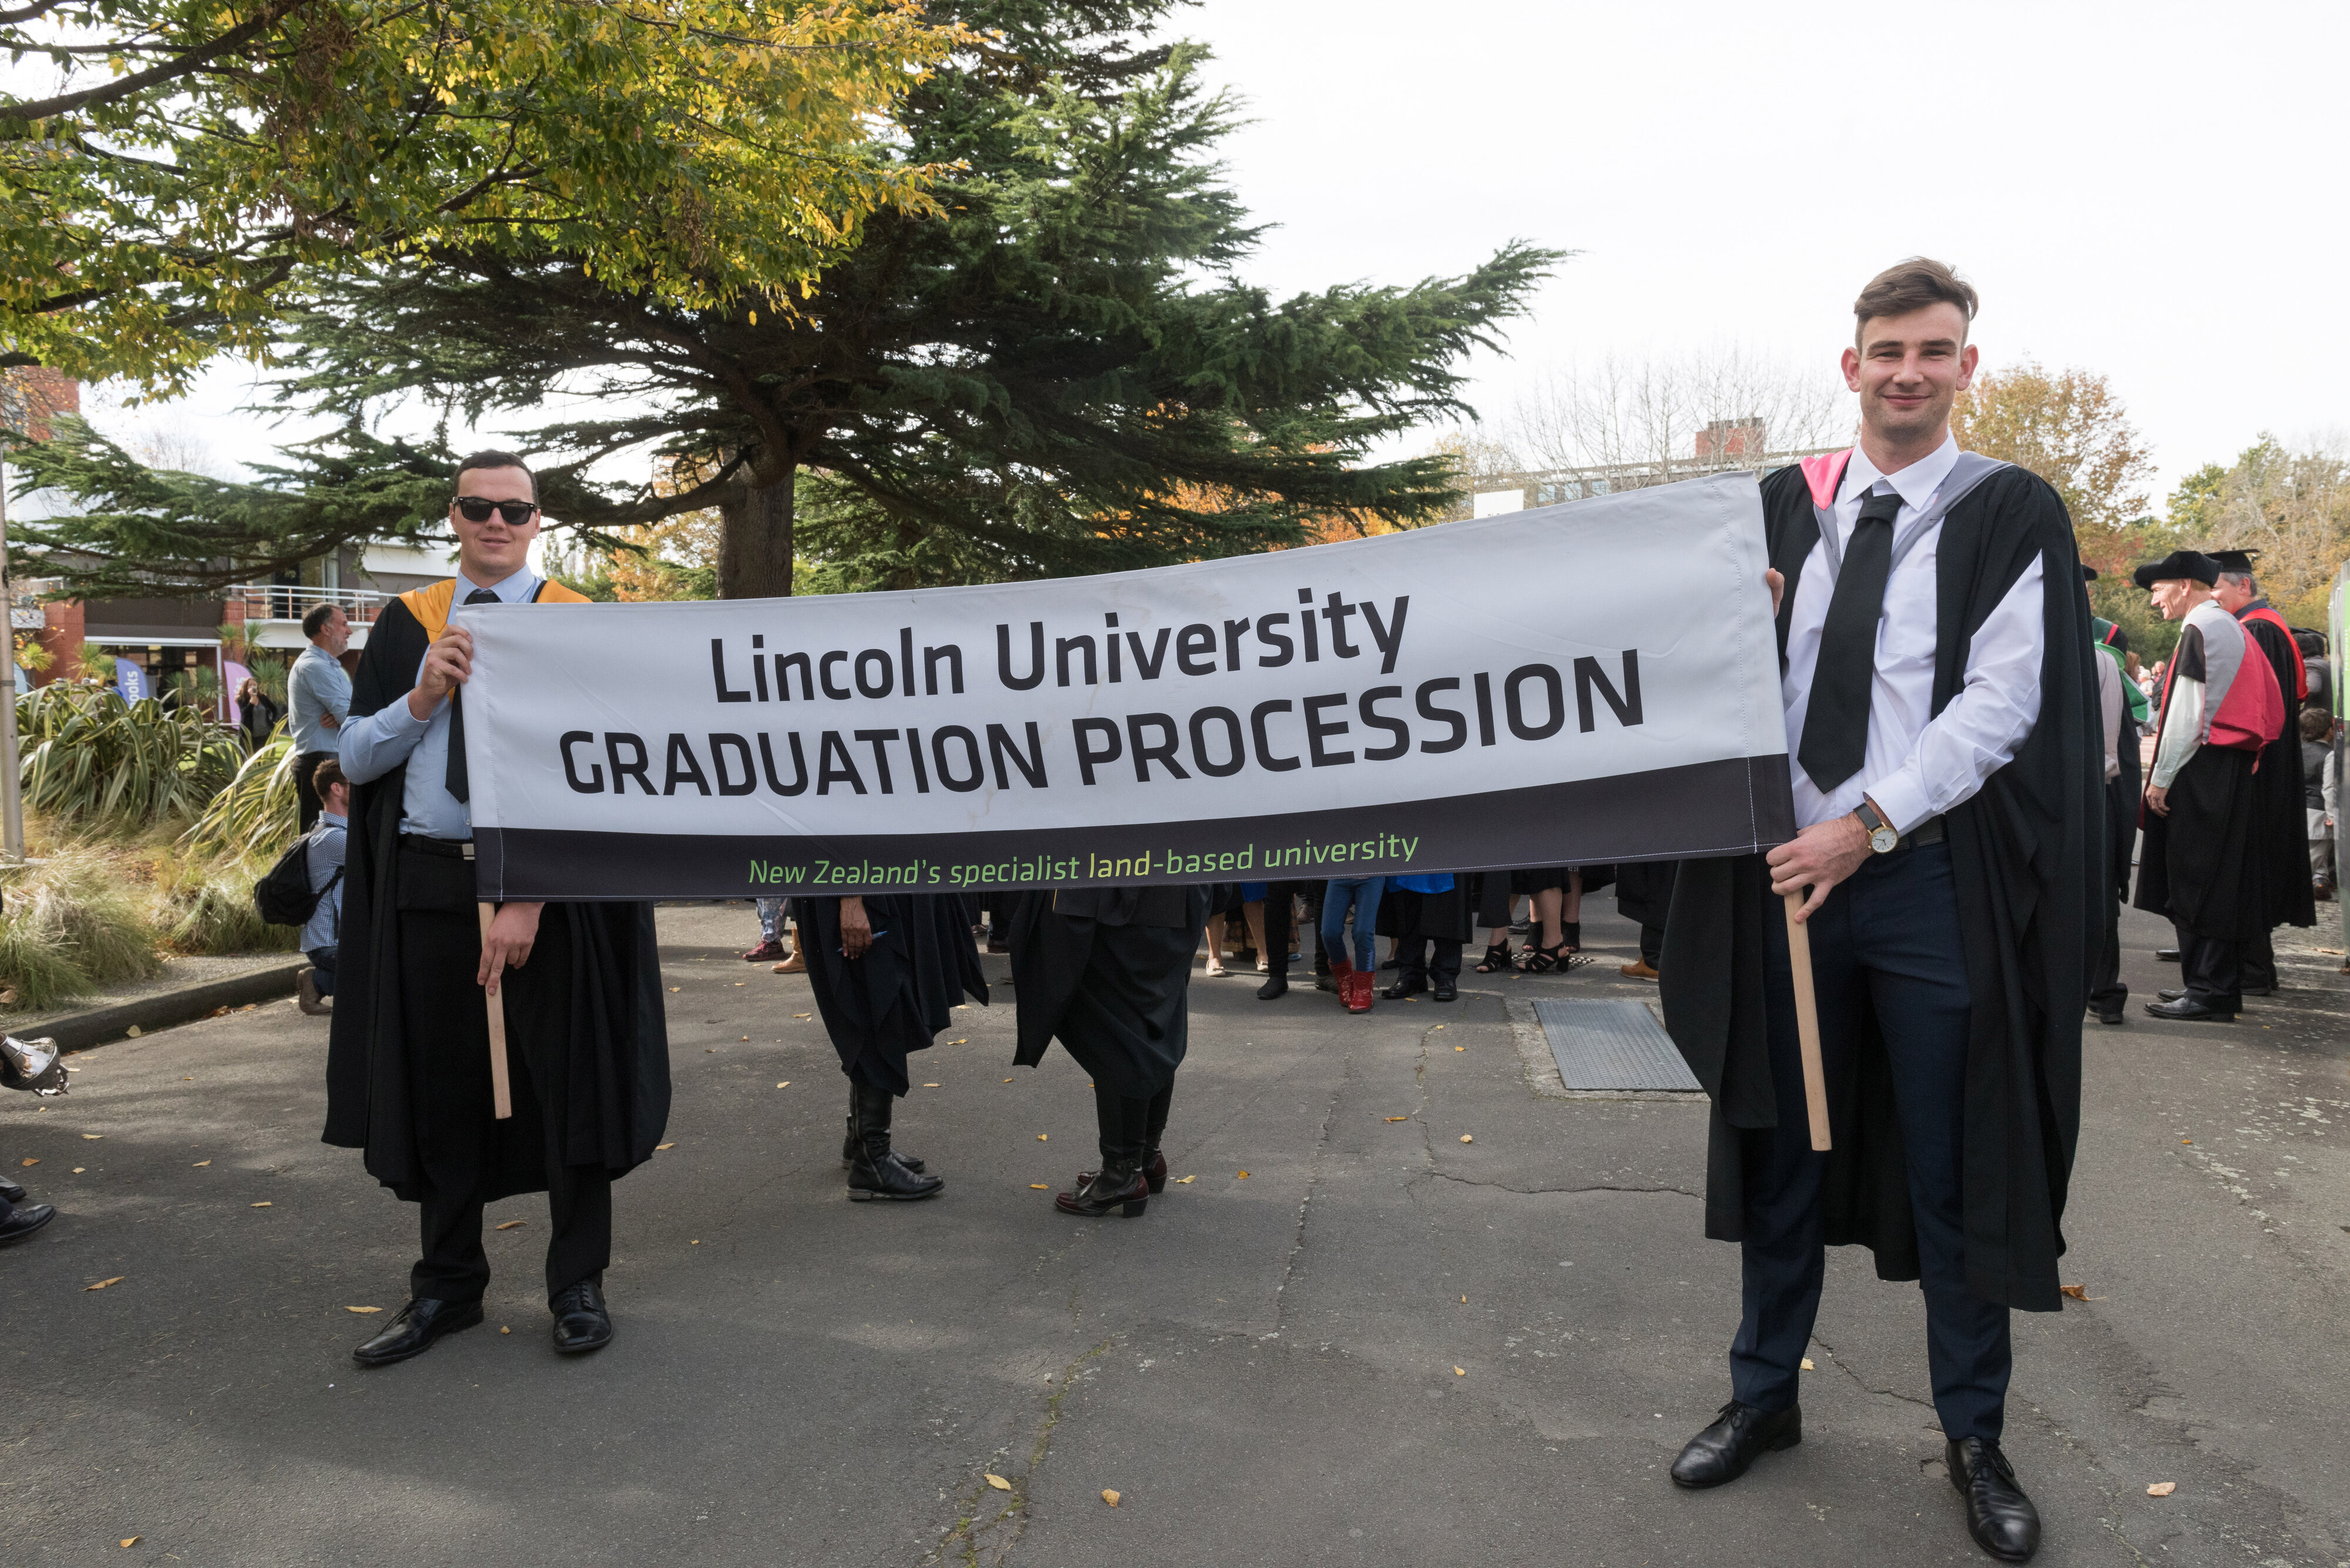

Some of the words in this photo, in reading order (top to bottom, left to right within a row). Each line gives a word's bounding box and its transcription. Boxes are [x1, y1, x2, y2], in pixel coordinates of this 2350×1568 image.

[711, 626, 964, 703] Lincoln
[996, 587, 1410, 691] University
[559, 721, 1049, 797] GRADUATION
[1072, 649, 1644, 786] PROCESSION
[749, 859, 806, 884] New
[813, 859, 940, 884] Zealand's
[949, 856, 1080, 888] specialist
[1089, 844, 1253, 878] land-based
[1264, 832, 1419, 868] university
